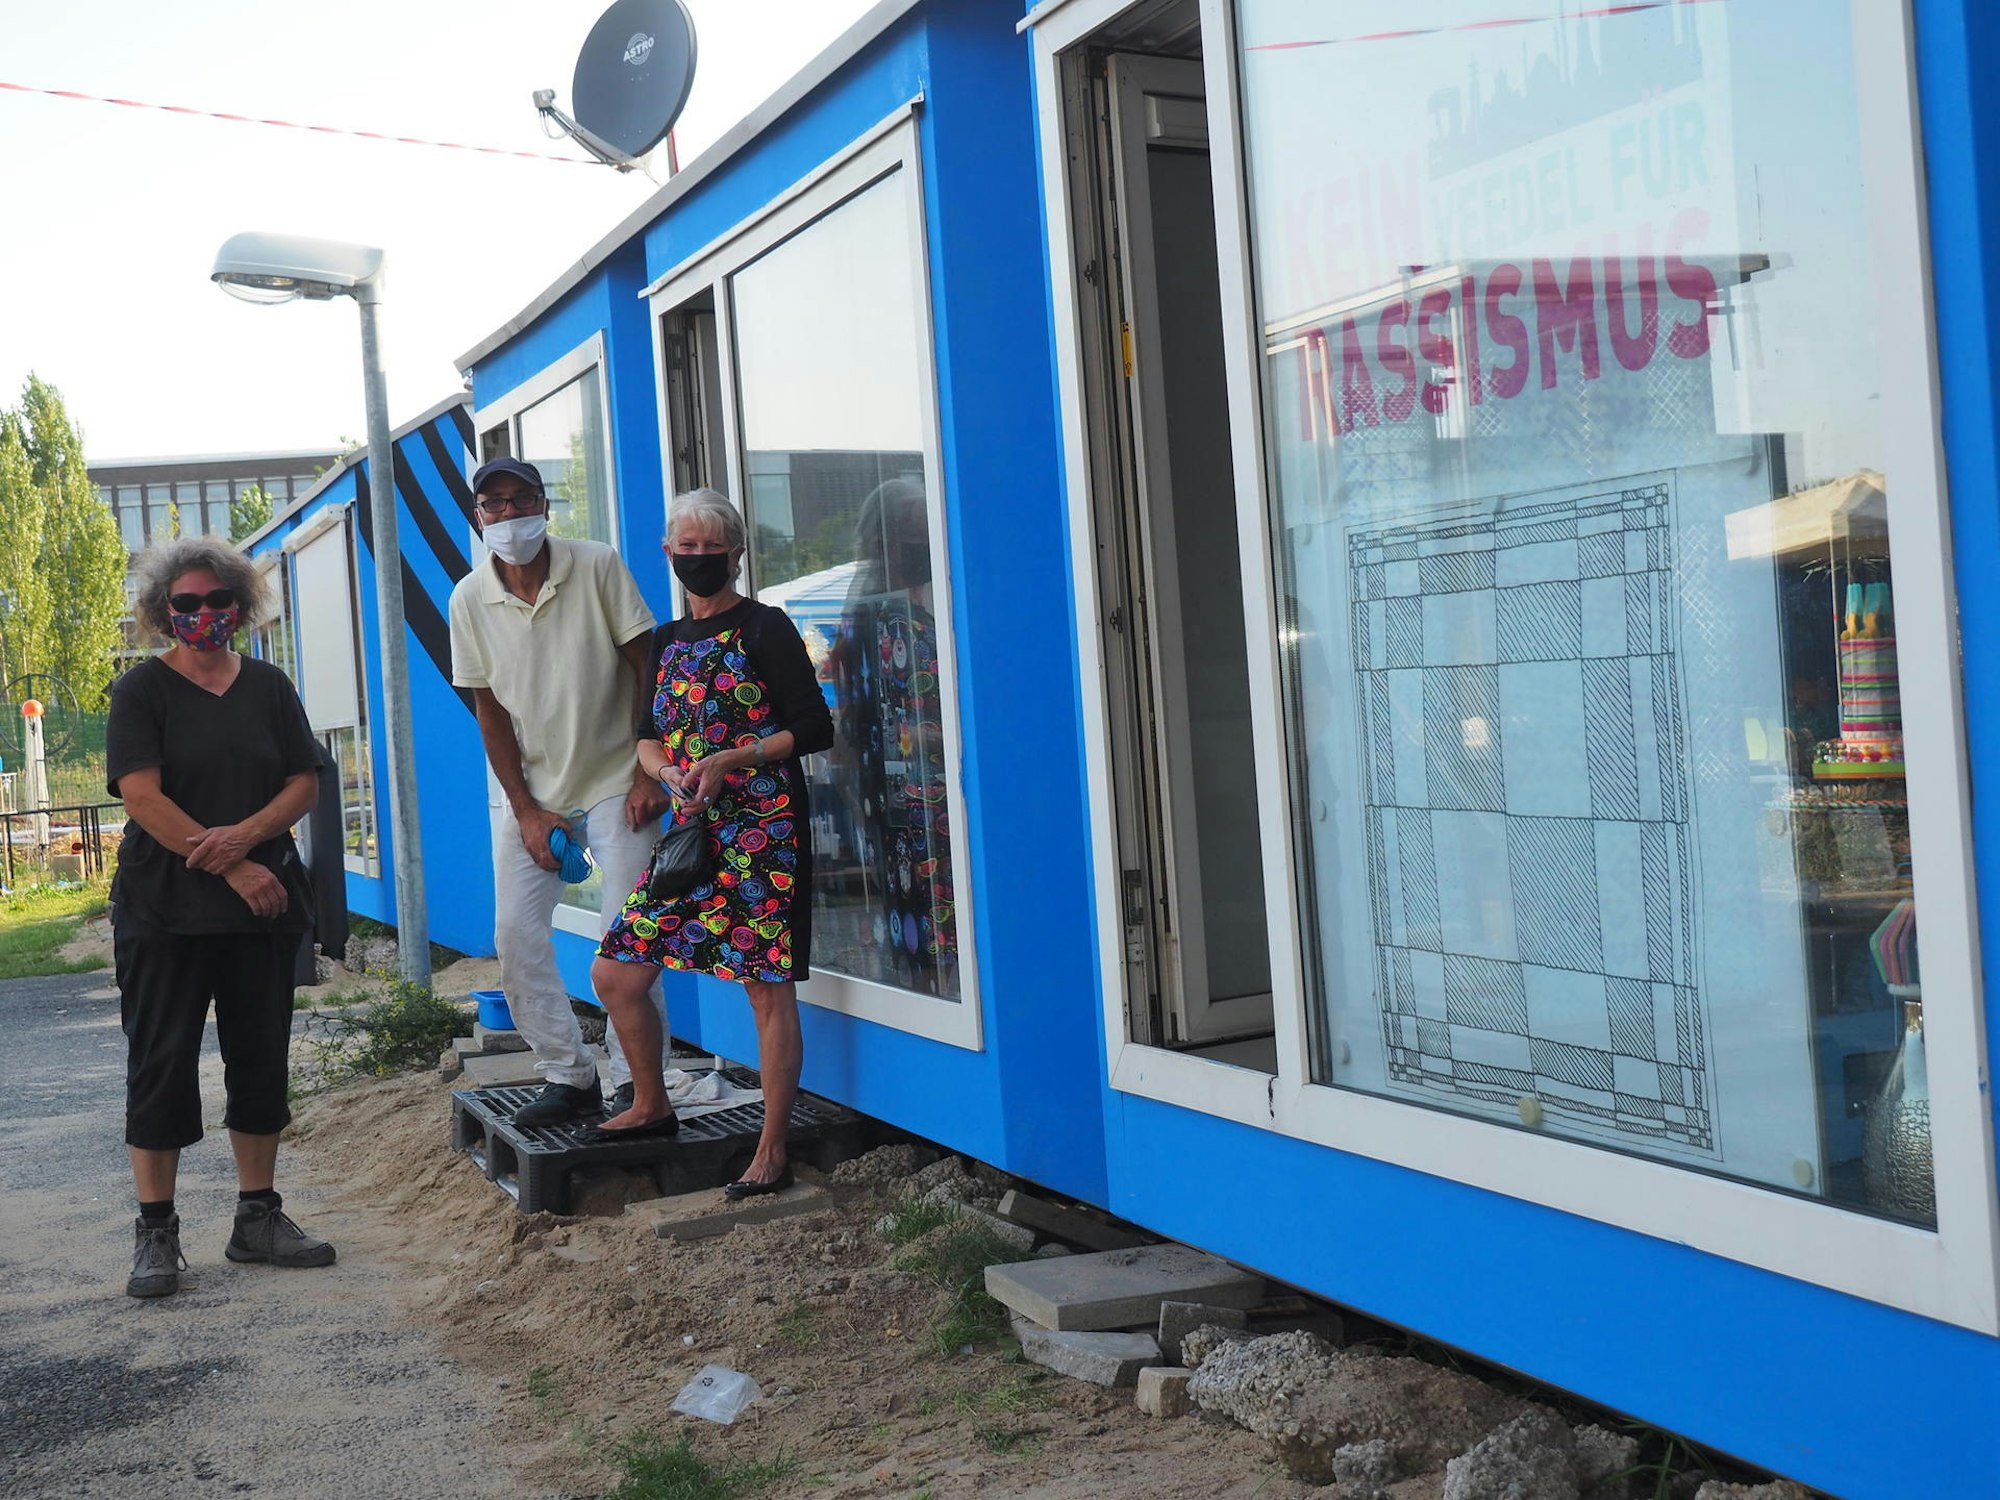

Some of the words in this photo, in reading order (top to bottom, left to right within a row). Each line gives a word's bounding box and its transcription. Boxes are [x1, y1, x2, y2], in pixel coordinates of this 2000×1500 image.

[623, 37, 655, 62] ASTRO
[1280, 149, 1427, 306] KEIN
[1607, 85, 1711, 213] FÜR
[1296, 207, 1721, 442] RASSISMUS
